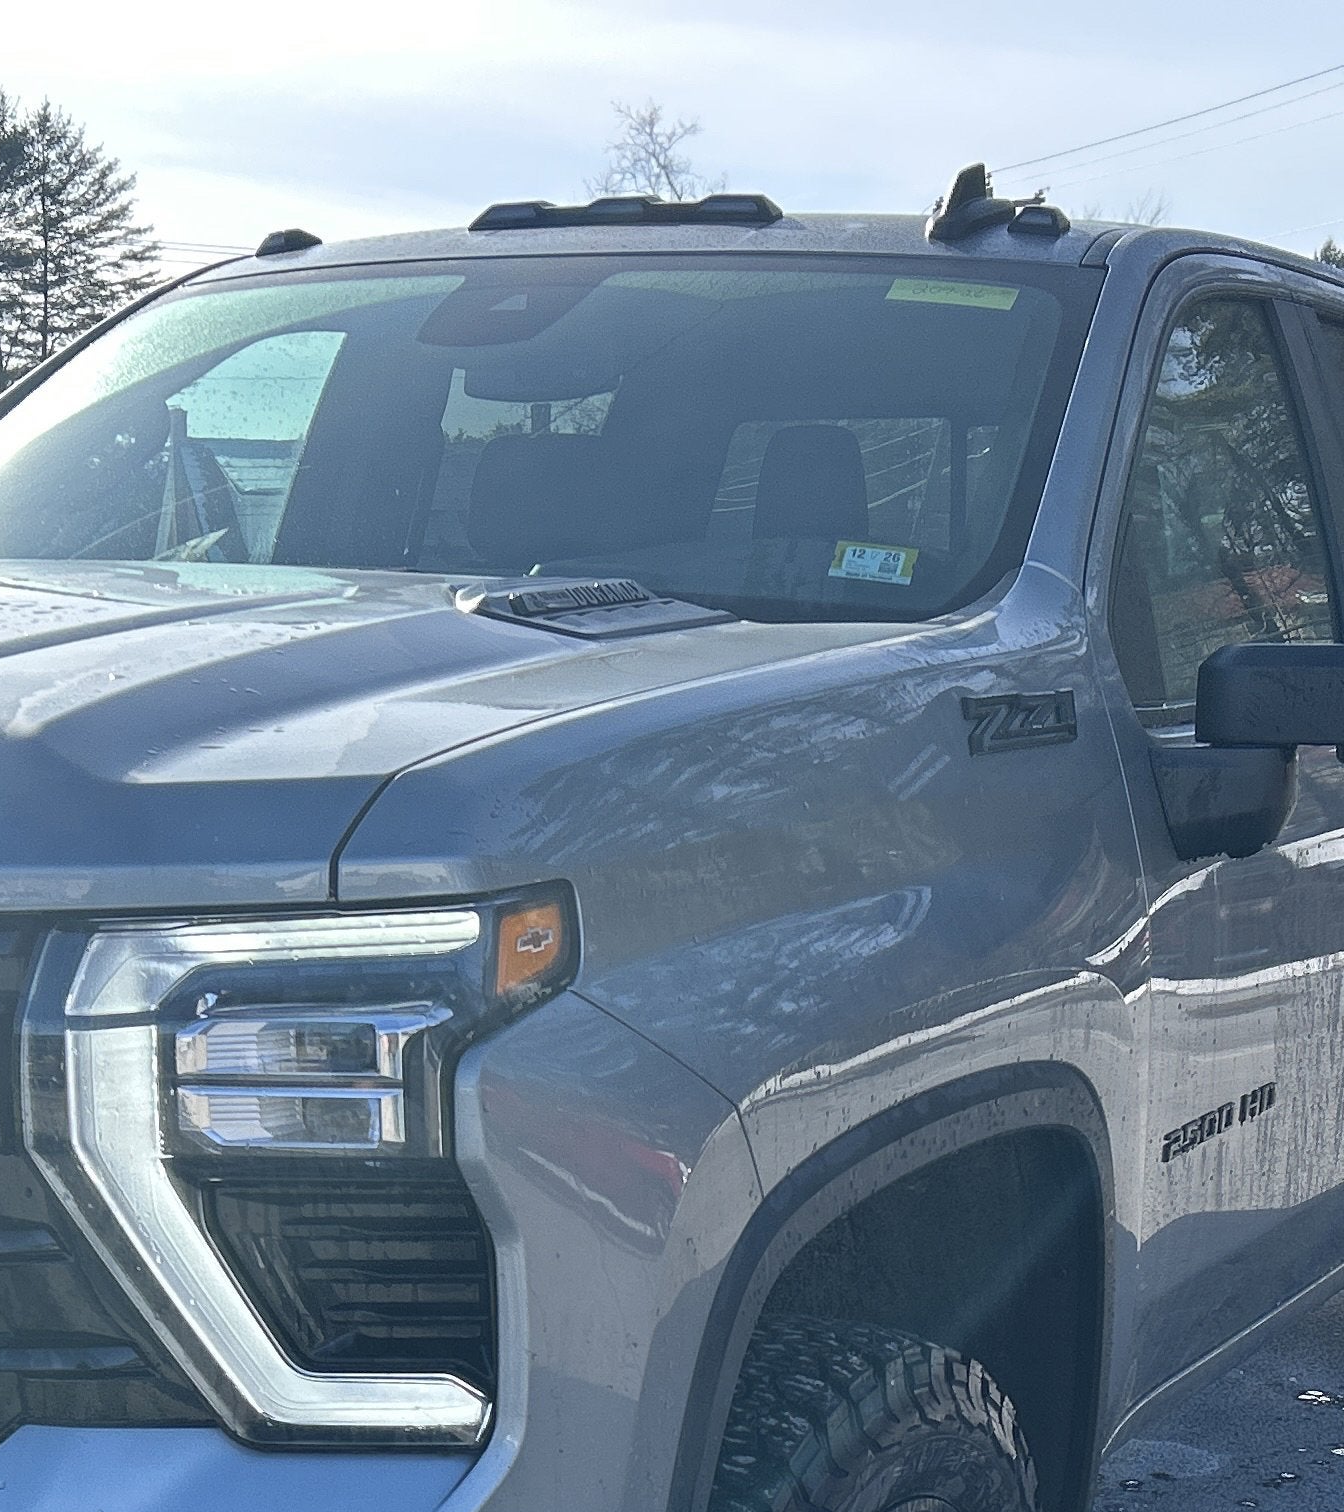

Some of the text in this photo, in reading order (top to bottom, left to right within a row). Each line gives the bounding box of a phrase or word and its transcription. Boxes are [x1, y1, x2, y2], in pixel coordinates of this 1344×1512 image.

[851, 547, 901, 563] 12 26
[1161, 1081, 1277, 1163] 2500 HD
